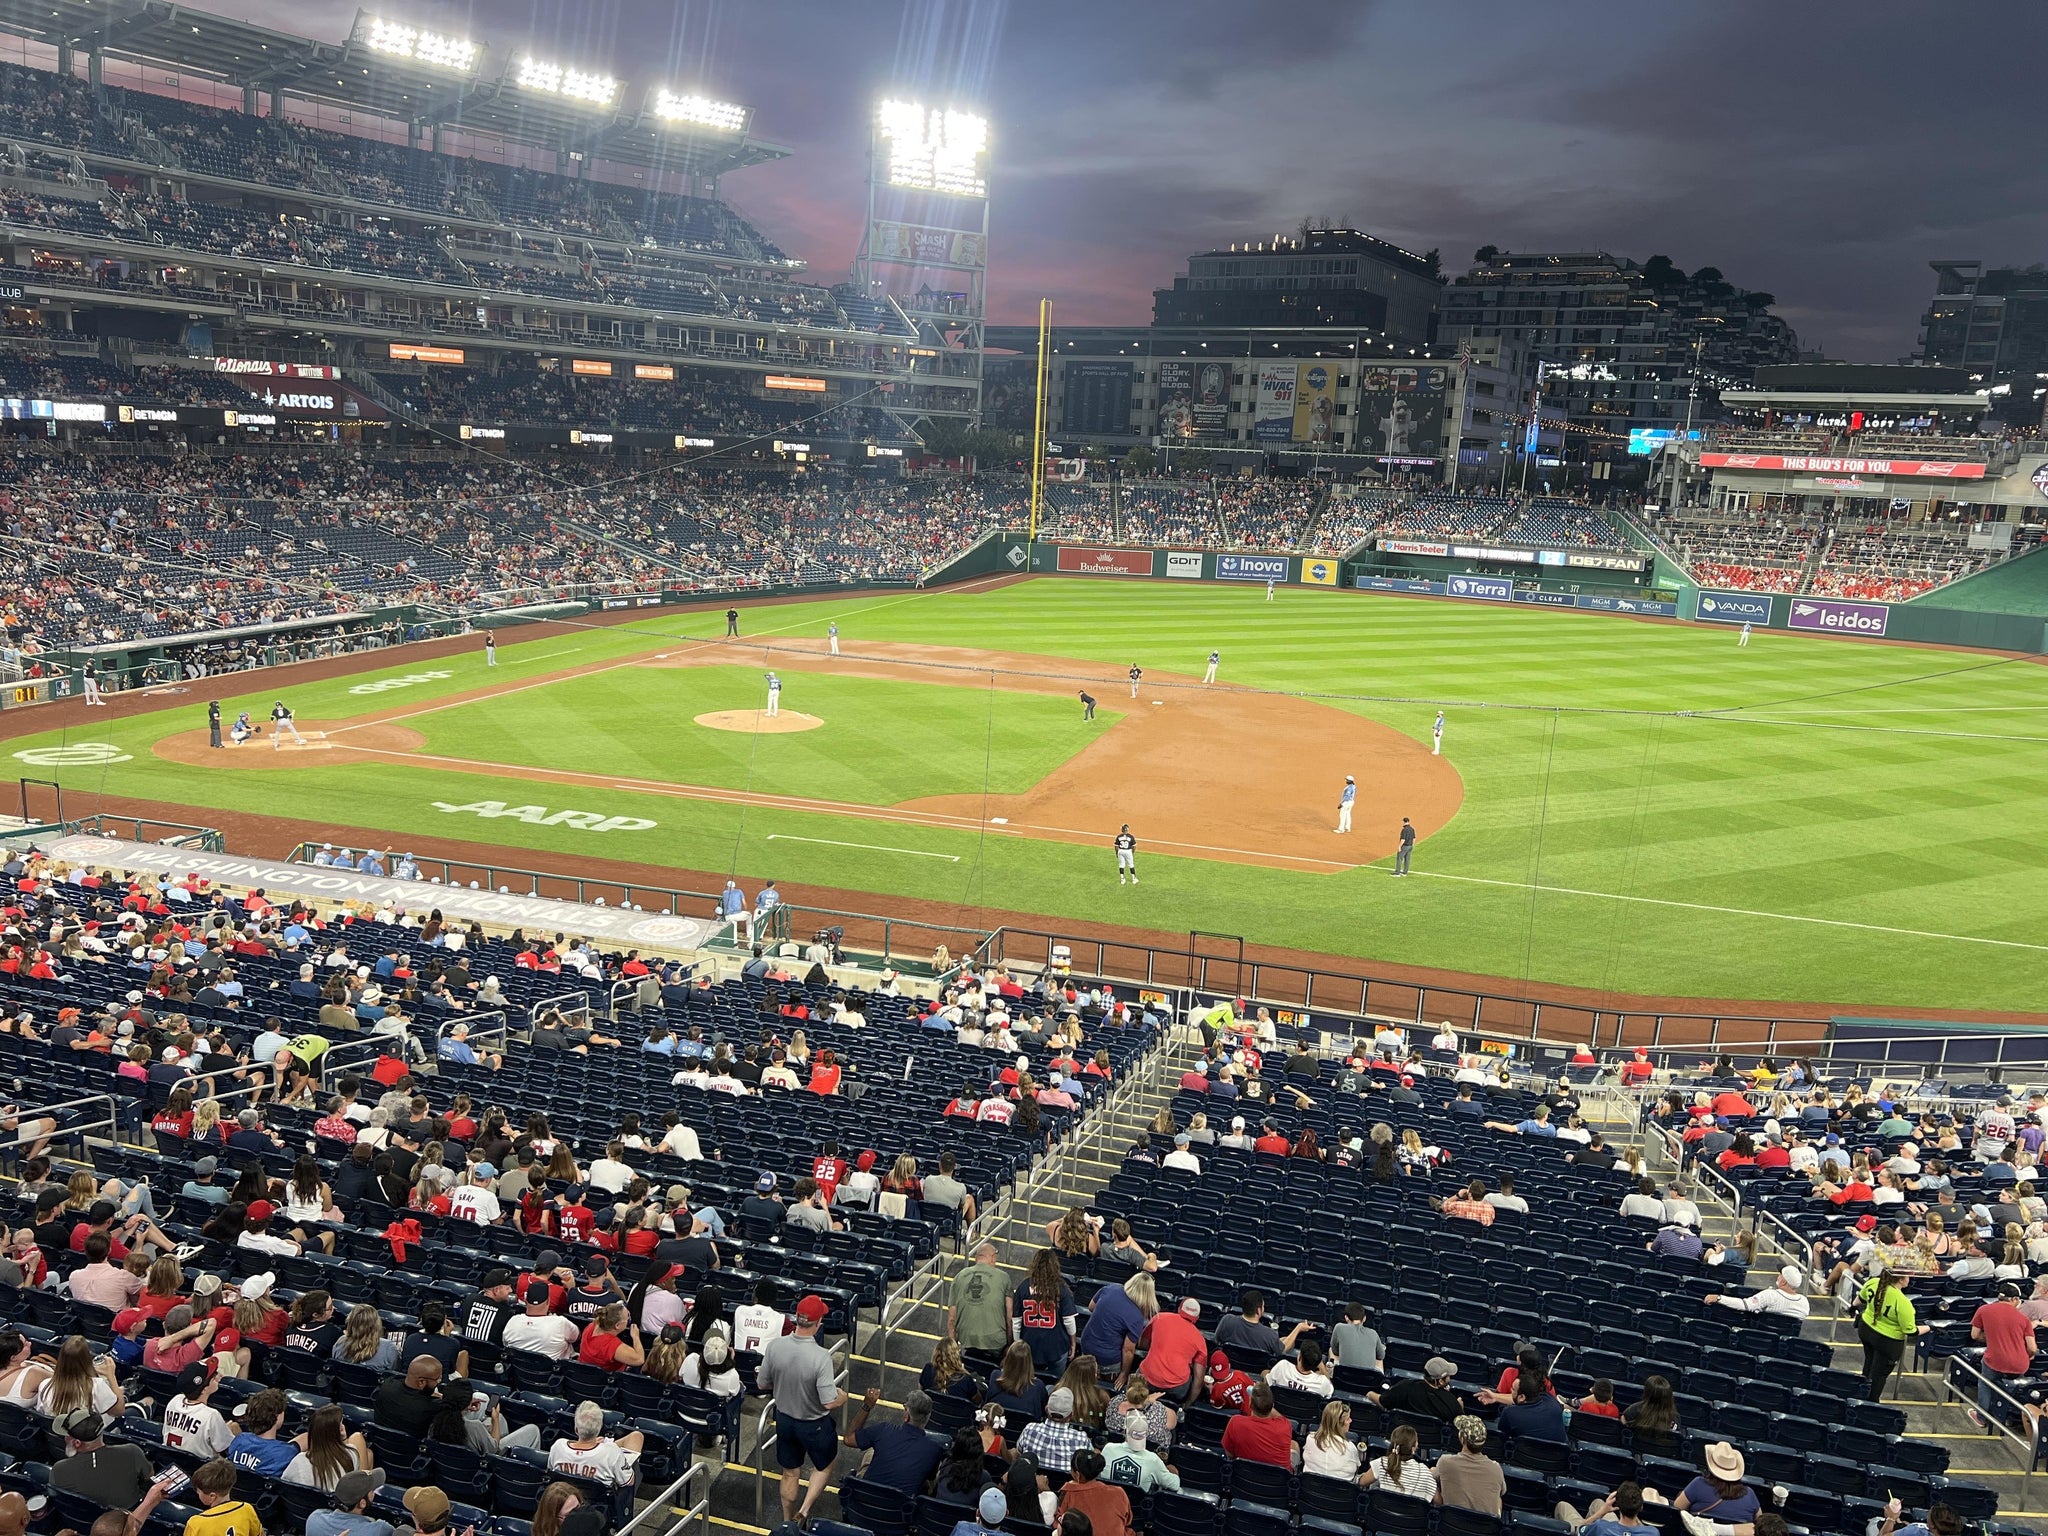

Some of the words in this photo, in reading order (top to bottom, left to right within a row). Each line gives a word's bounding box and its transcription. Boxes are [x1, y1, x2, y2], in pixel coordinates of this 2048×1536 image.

[914, 231, 946, 249] SMASH
[0, 287, 22, 297] LUB
[1263, 381, 1294, 390] HVAC
[278, 393, 334, 409] ARTOIS
[1274, 391, 1292, 401] 911
[134, 410, 177, 421] BETMGM
[238, 415, 276, 425] BETMGM
[1817, 417, 1847, 427] ULTRA
[1864, 419, 1895, 428] LOFT
[472, 429, 505, 438] BETMGM
[581, 434, 613, 442] BETMGM
[1782, 457, 1808, 469] THIS
[1808, 459, 1841, 471] BUD'S
[1843, 460, 1865, 472] FOR
[1865, 461, 1893, 473] YOU.
[2031, 475, 2048, 484] CHA
[1393, 543, 1418, 551] Harris
[1419, 545, 1446, 554] Teeter
[1032, 557, 1041, 566] 336
[1169, 557, 1201, 565] GDIT
[1240, 558, 1283, 572] Inova
[1604, 557, 1640, 569] FAN
[1080, 562, 1128, 573] Budweiser
[1468, 582, 1506, 597] Terra
[1569, 585, 1580, 593] 377
[1539, 595, 1563, 603] CLEAR
[1642, 602, 1662, 610] MGM
[1716, 601, 1765, 613] VANDA
[1819, 609, 1882, 630] leidos
[431, 800, 658, 832] AARP
[122, 849, 381, 894] WASHINGTON
[378, 885, 617, 928] NATIONALS
[679, 1078, 696, 1086] CREWS
[154, 1121, 180, 1131] ABRAMS
[1986, 1125, 2008, 1139] 26
[815, 1165, 836, 1180] 22
[459, 1193, 474, 1203] GRAY
[451, 1204, 476, 1221] 40
[472, 1301, 499, 1311] FREEDOM
[1023, 1299, 1056, 1328] 29
[743, 1319, 769, 1330] DANIELS
[286, 1334, 318, 1353] TURNER
[167, 1410, 201, 1434] ABRAMS
[233, 1450, 261, 1471] LOWE
[558, 1462, 597, 1478] TAYLOR
[1115, 1463, 1135, 1474] Huk
